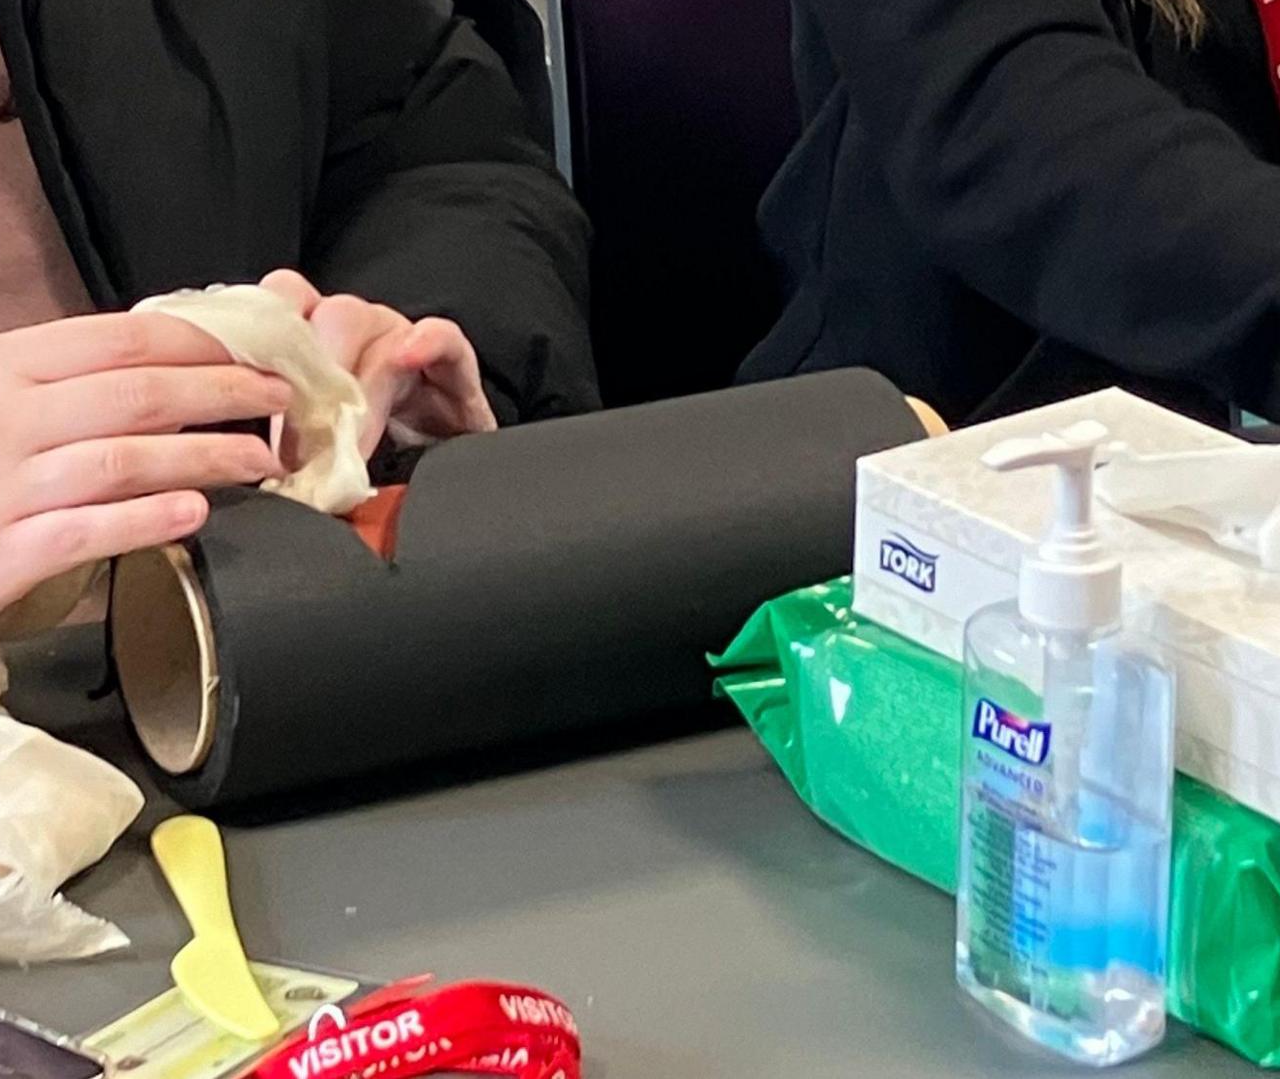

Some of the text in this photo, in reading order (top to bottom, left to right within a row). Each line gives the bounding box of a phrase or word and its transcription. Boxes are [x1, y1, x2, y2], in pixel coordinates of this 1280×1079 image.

[882, 543, 934, 589] TORK
[978, 700, 1044, 763] Purell
[499, 993, 579, 1036] VISITO
[288, 1010, 425, 1079] VISITOR
